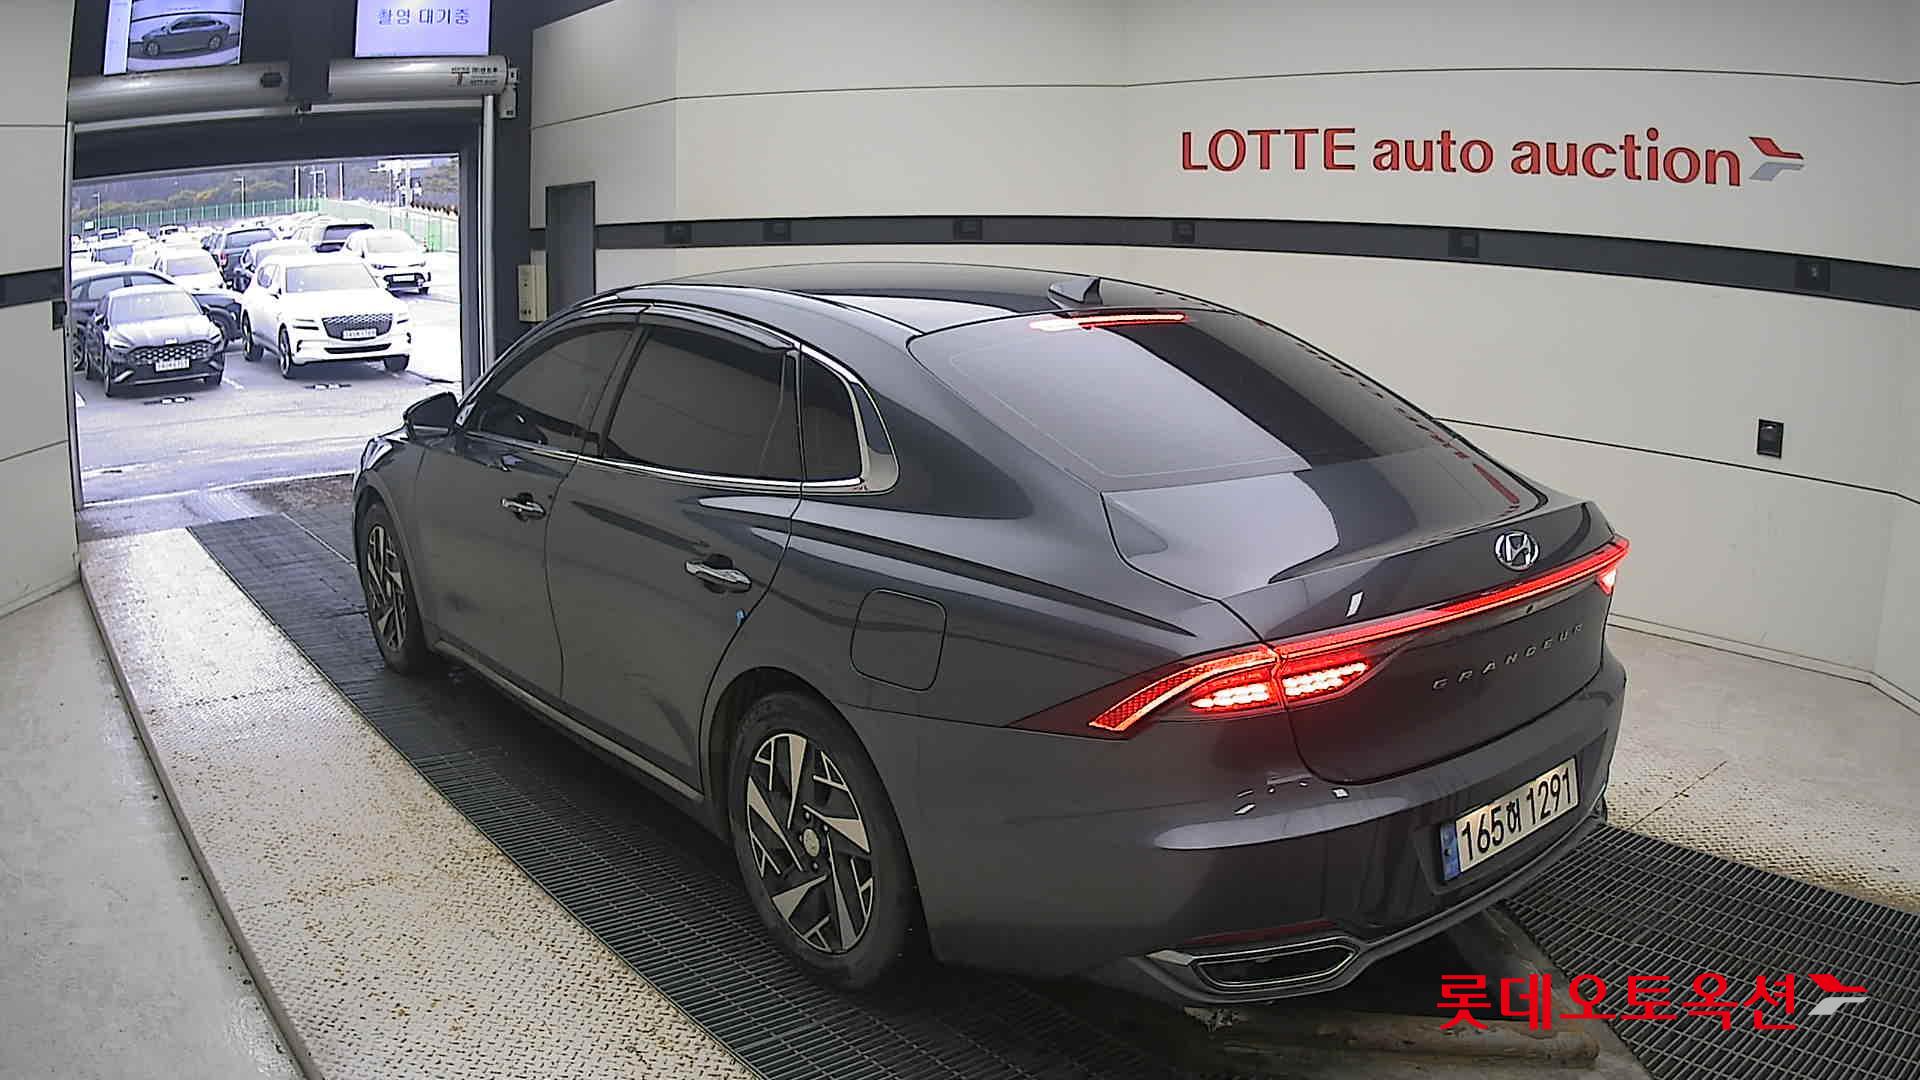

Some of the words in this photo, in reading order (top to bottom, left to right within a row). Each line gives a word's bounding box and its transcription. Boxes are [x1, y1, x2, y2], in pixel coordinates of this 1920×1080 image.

[418, 8, 470, 25] 대기중
[1181, 127, 1356, 172] LOTTE
[1372, 130, 1495, 175] auto
[1511, 127, 1742, 187] auction
[1431, 623, 1584, 691] GRANDEUR
[1526, 767, 1572, 826] 1291
